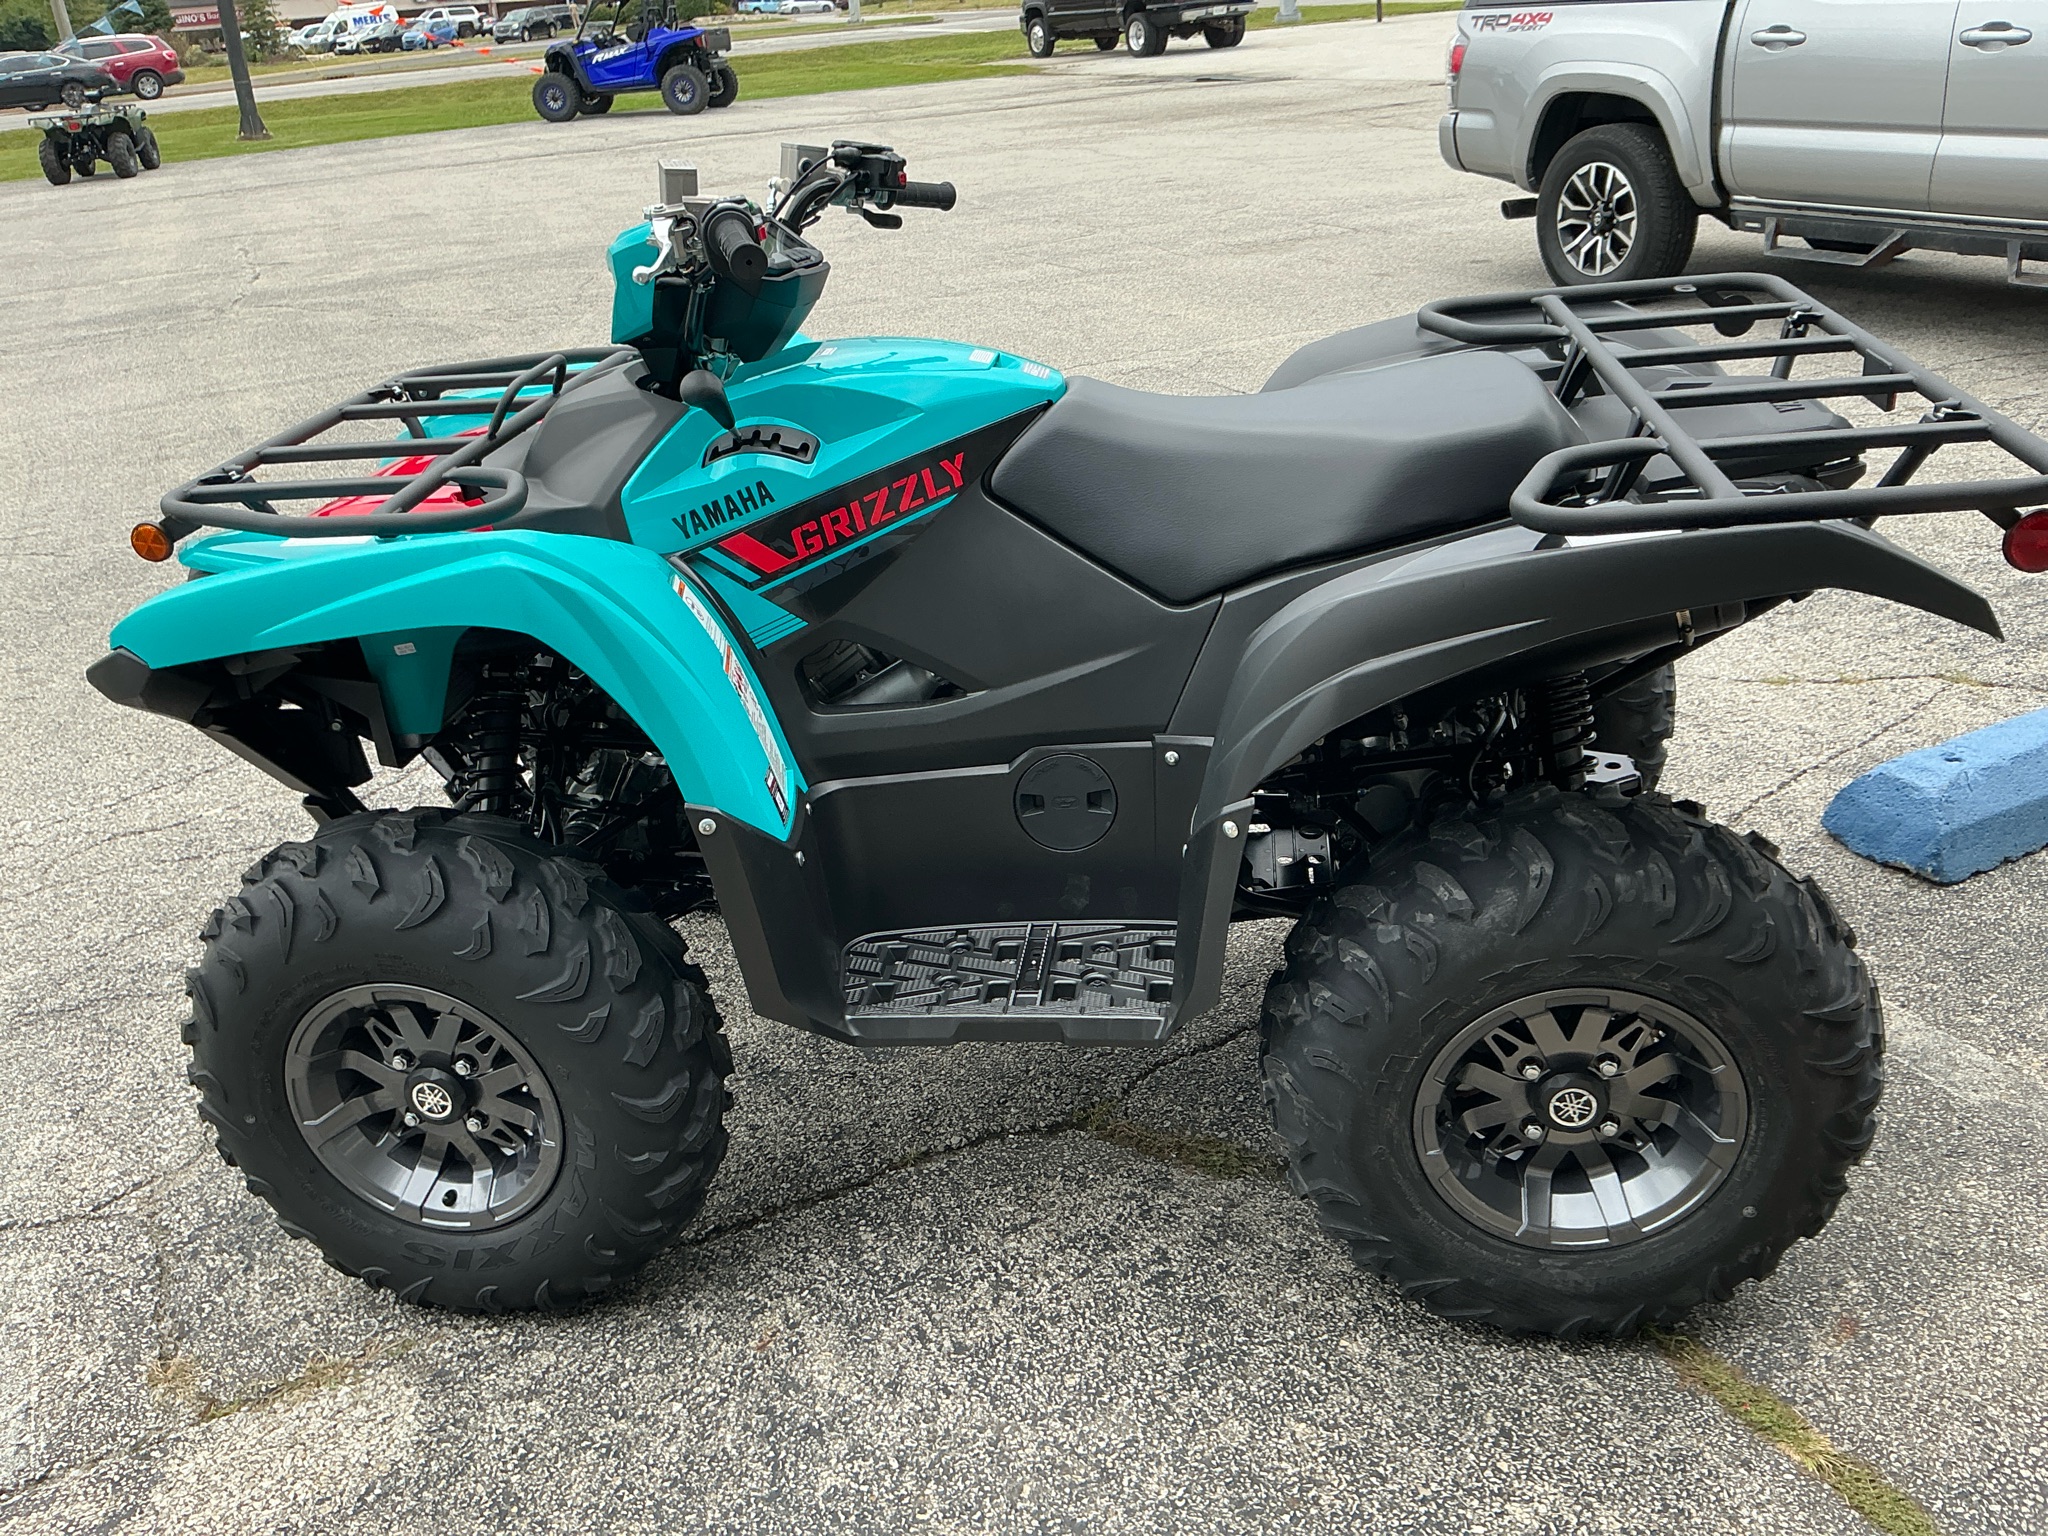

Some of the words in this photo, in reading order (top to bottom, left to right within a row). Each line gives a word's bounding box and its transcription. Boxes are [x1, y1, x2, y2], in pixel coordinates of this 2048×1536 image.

[671, 480, 776, 540] YAMAHA
[788, 452, 965, 557] GRIZZLY
[399, 1112, 597, 1272] MAXXIS
